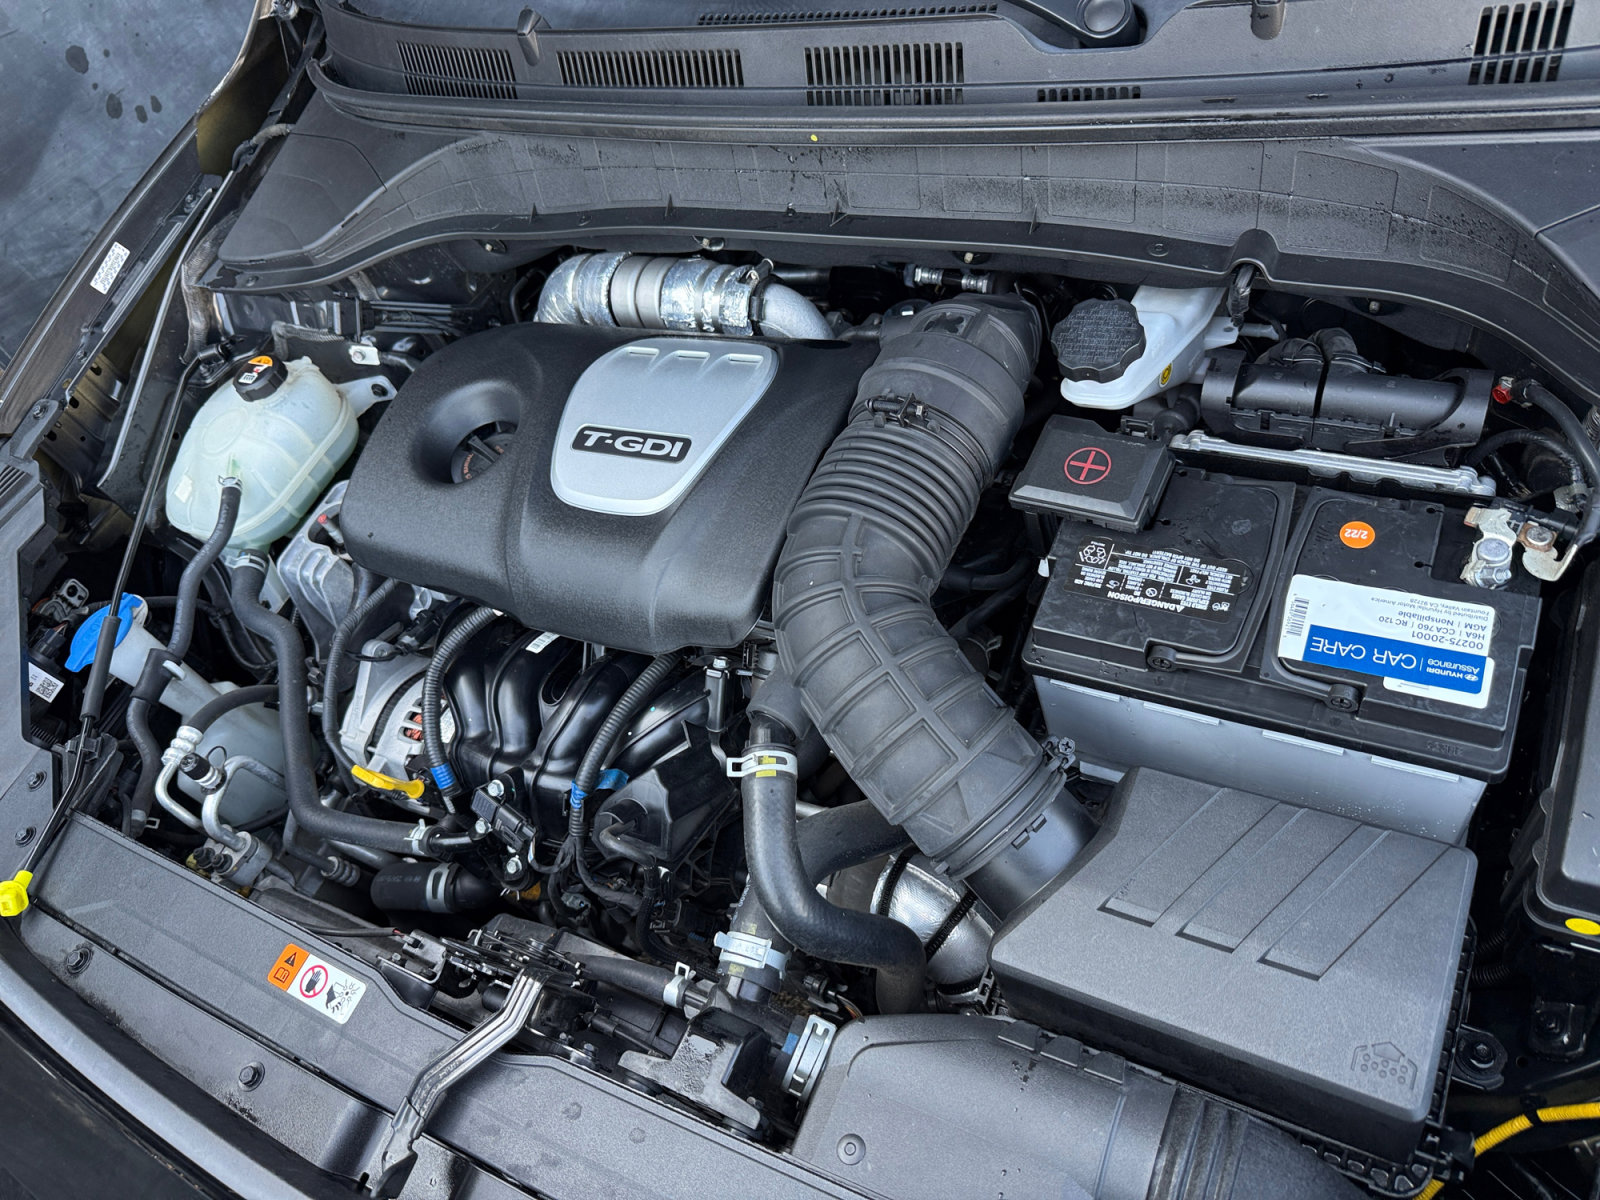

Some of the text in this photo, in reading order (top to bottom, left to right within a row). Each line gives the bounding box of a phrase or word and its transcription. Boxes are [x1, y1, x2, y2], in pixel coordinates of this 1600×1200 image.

[1344, 528, 1368, 539] 2/22
[1107, 591, 1175, 610] DANGER/POISON
[1378, 615, 1484, 640] H6A CCA 760 RC 120
[1397, 610, 1486, 631] AGM Nonspillable
[1410, 630, 1483, 649] 00275-20001
[1309, 636, 1417, 670] CAR CARE
[1426, 666, 1463, 678] HYUNDAI
[1427, 658, 1479, 674] Assurance
